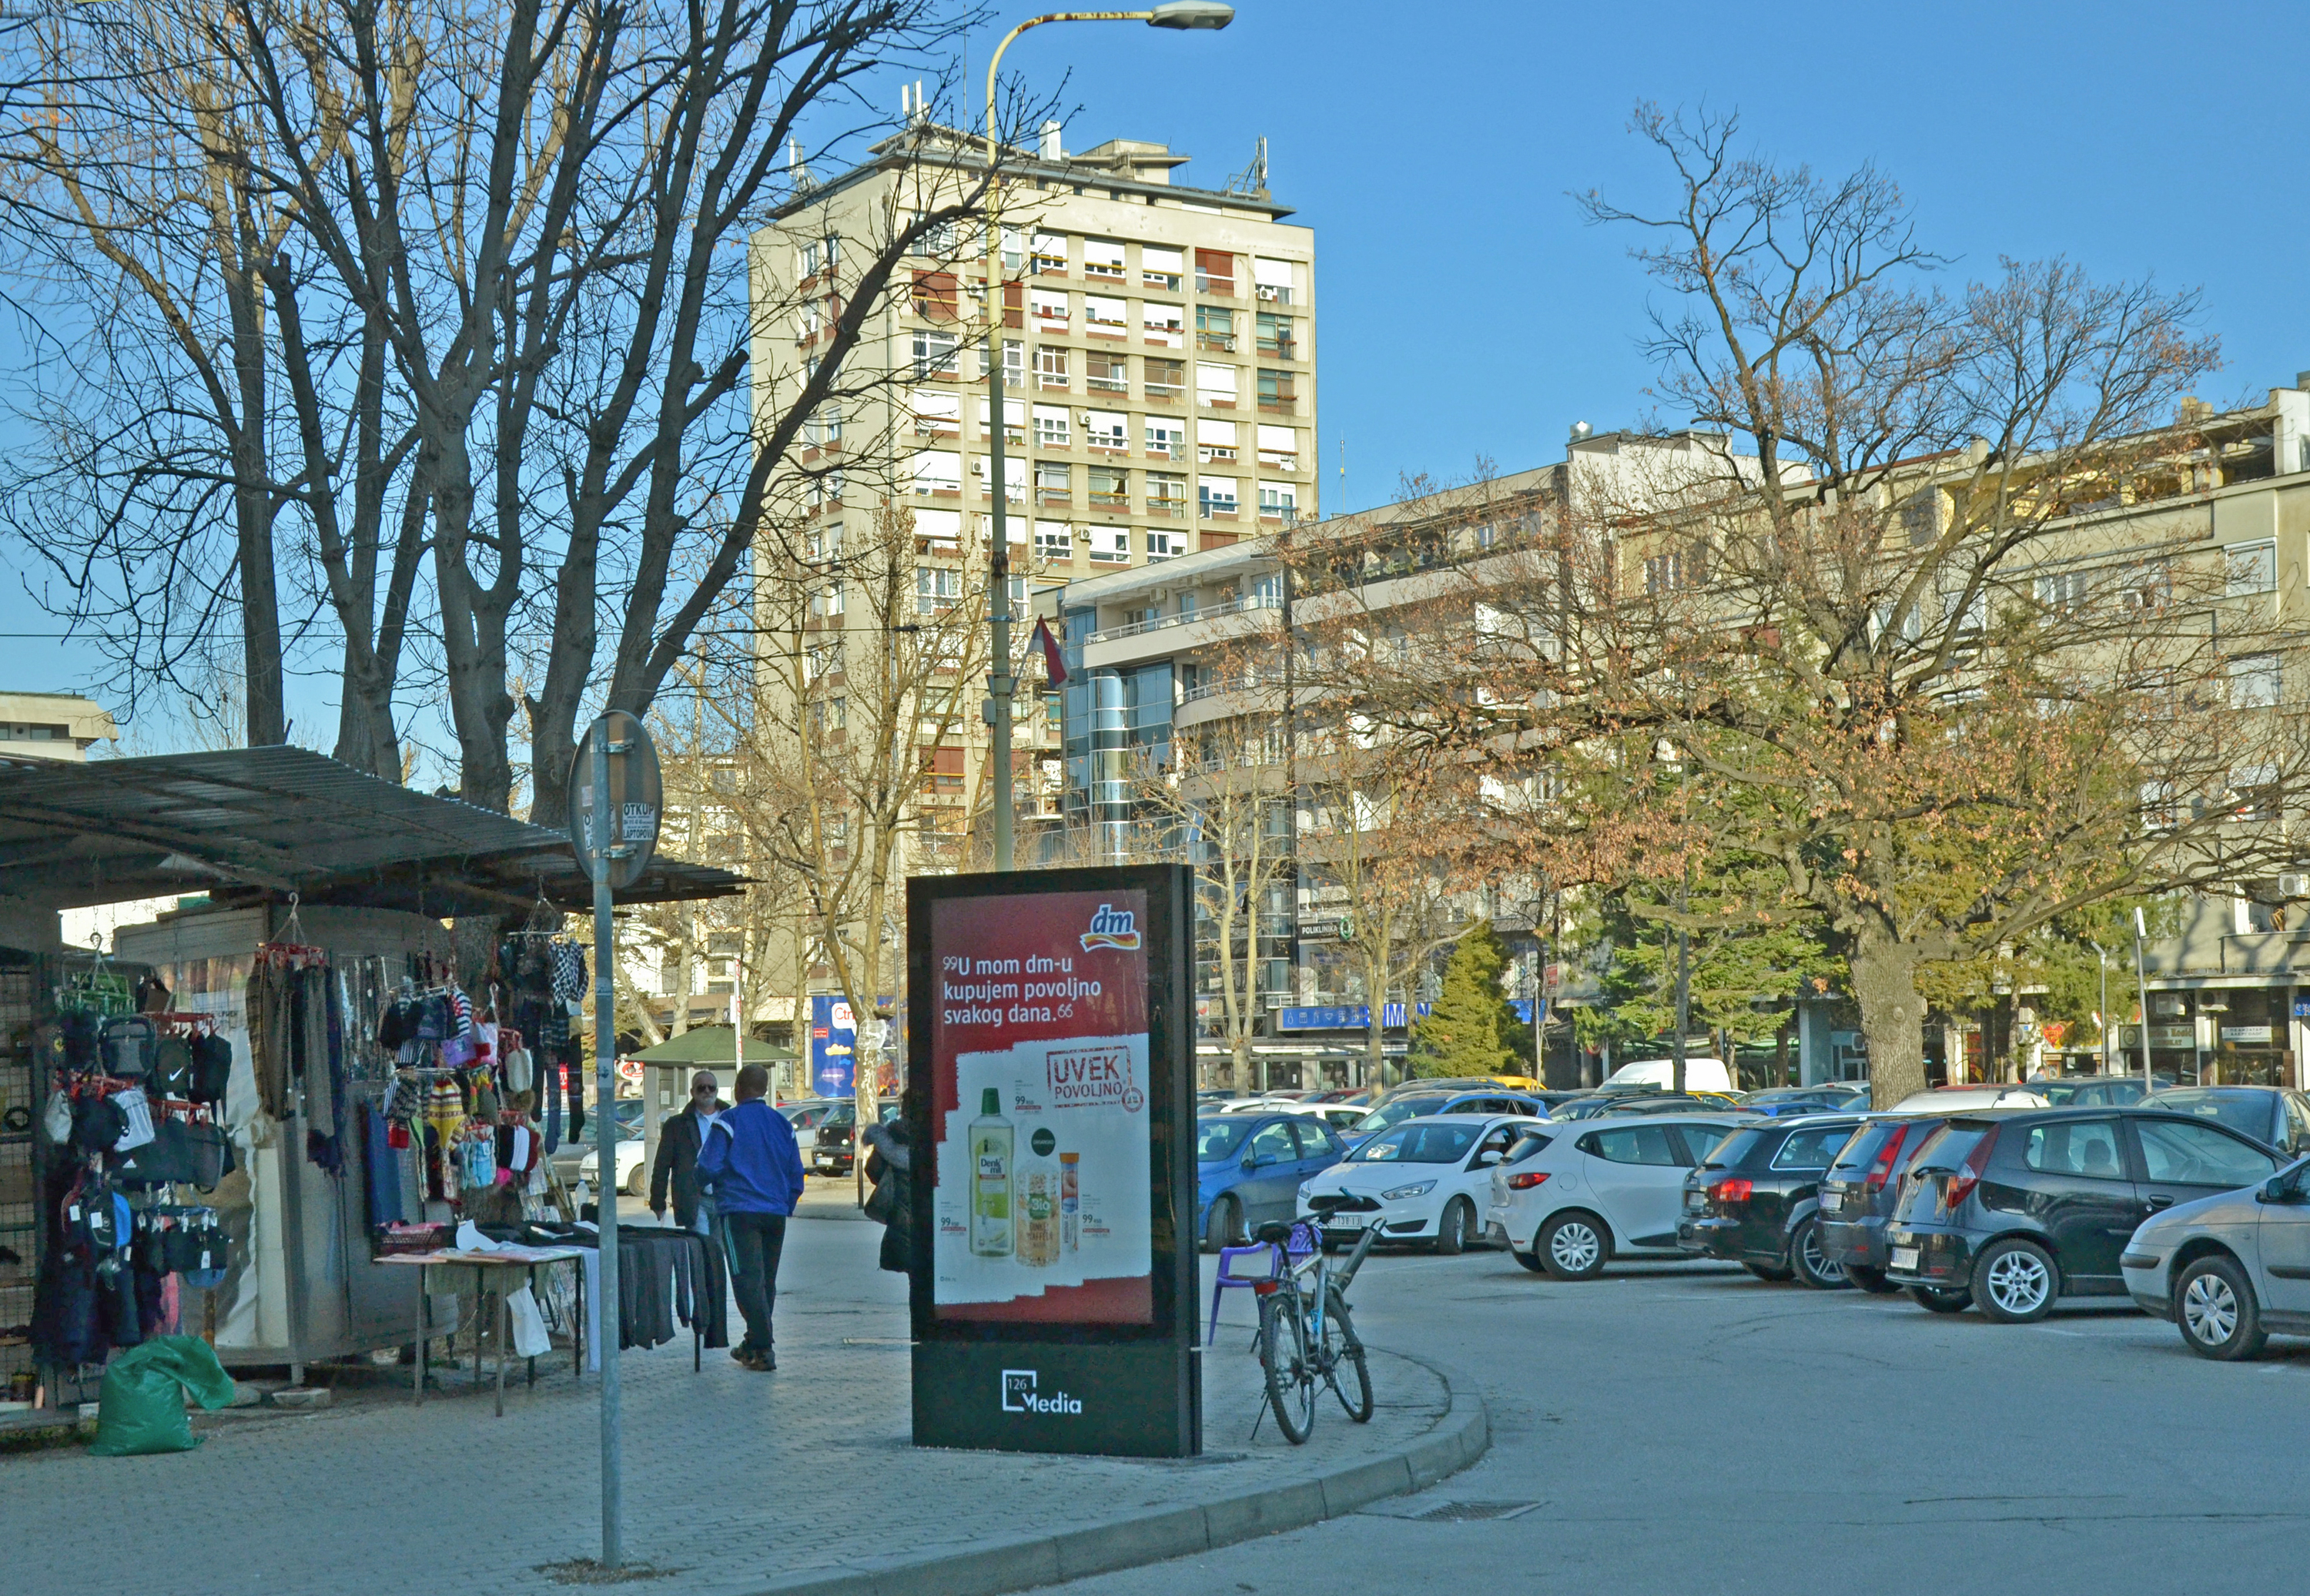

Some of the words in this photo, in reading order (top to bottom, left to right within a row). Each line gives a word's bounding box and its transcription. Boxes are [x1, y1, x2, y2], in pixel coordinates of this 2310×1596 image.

[624, 804, 654, 816] OTKUP
[1093, 907, 1132, 933] dm
[1301, 924, 1338, 935] POLIKLINIKA
[976, 959, 1020, 975] mom
[1026, 954, 1072, 973] dm-u
[944, 980, 1019, 1003] kupujem
[1024, 977, 1102, 1002] povoljno
[944, 1004, 1003, 1028] svakog
[1054, 1055, 1120, 1083] UVEK
[1055, 1082, 1123, 1099] POVOLJNO
[1015, 1096, 1026, 1106] 99
[980, 1158, 1000, 1167] Denk
[940, 1217, 951, 1226] 99
[1083, 1214, 1093, 1224] 99
[1007, 1378, 1027, 1390] 126
[1022, 1390, 1082, 1414] Media
